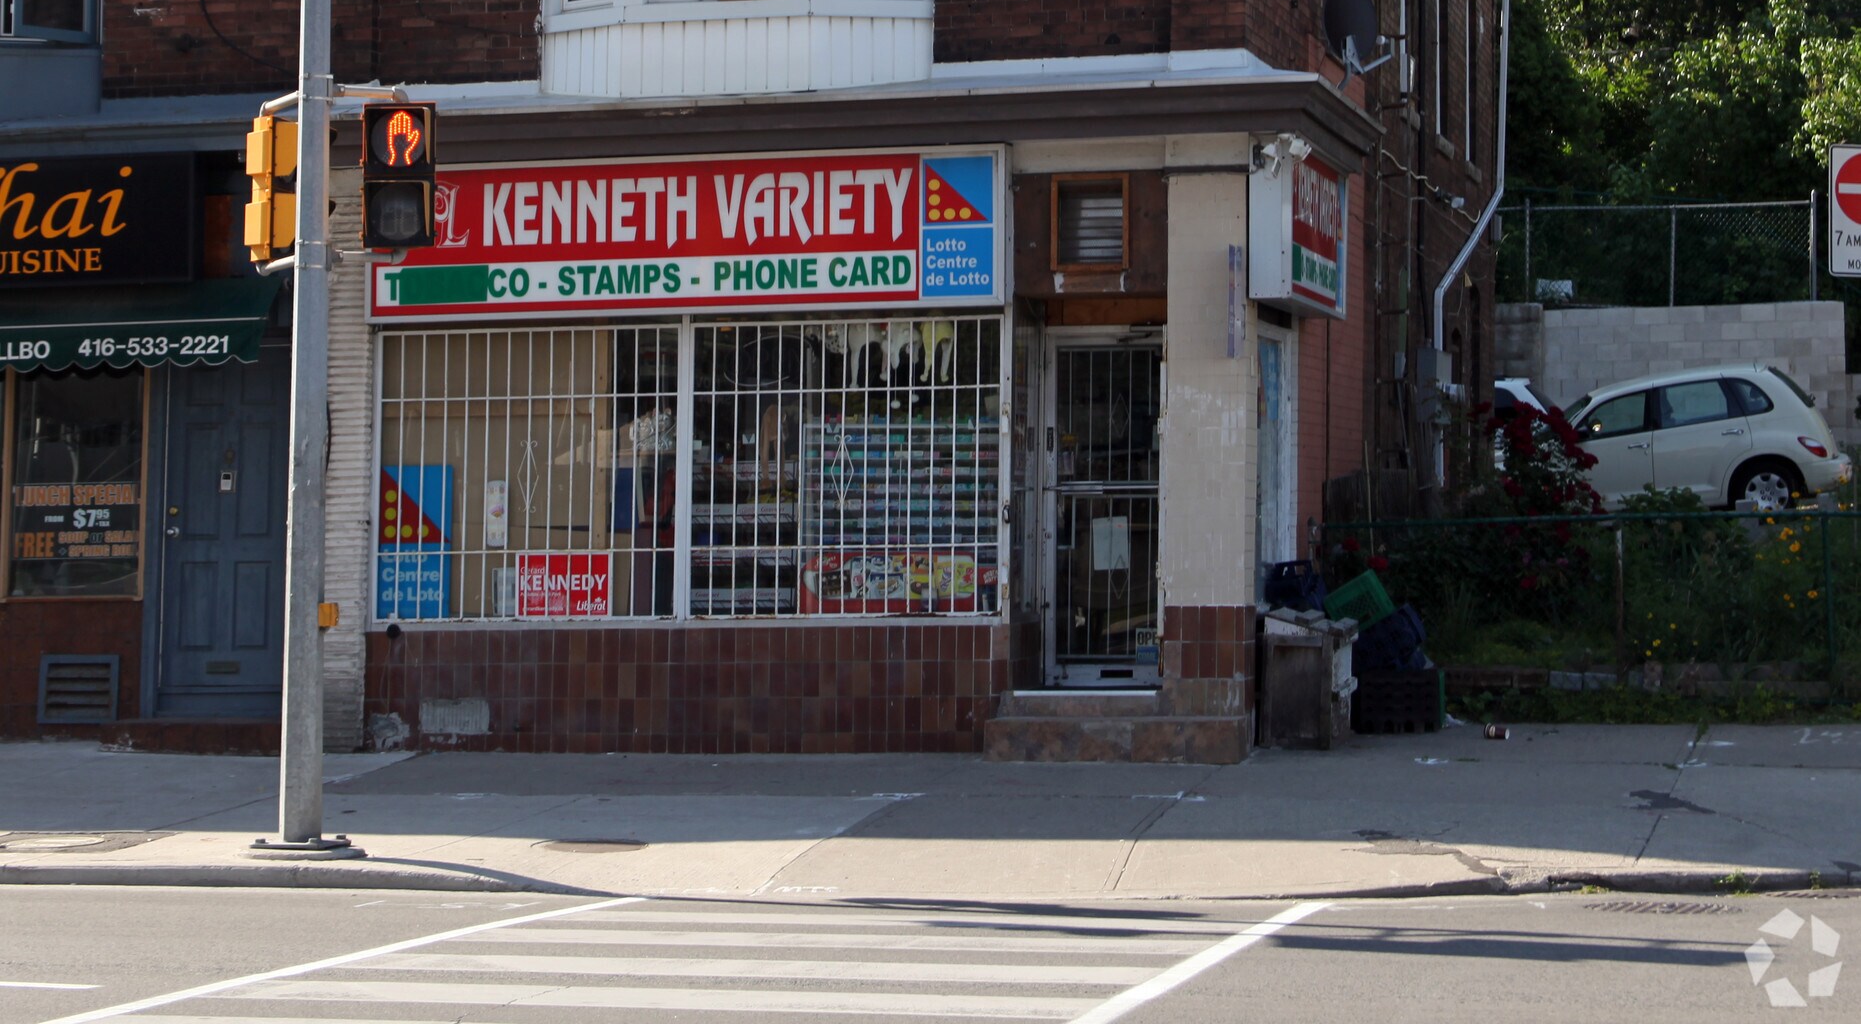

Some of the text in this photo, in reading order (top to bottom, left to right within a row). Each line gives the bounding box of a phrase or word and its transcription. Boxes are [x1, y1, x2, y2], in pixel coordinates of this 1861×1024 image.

[483, 176, 698, 249] KENNETH
[714, 168, 913, 246] VARIETY
[926, 237, 967, 253] Lotto
[1835, 230, 1843, 246] 7
[926, 255, 977, 270] Centre
[557, 262, 682, 296] STAMPS
[714, 257, 818, 292] PHONE
[828, 254, 912, 287] CARD
[925, 273, 990, 288] de Lotto
[78, 335, 229, 357] 416-533-2221
[15, 485, 71, 507] LUNCH
[14, 531, 56, 558] FREE
[520, 574, 606, 591] KENNEDY
[576, 600, 606, 611] Liberal
